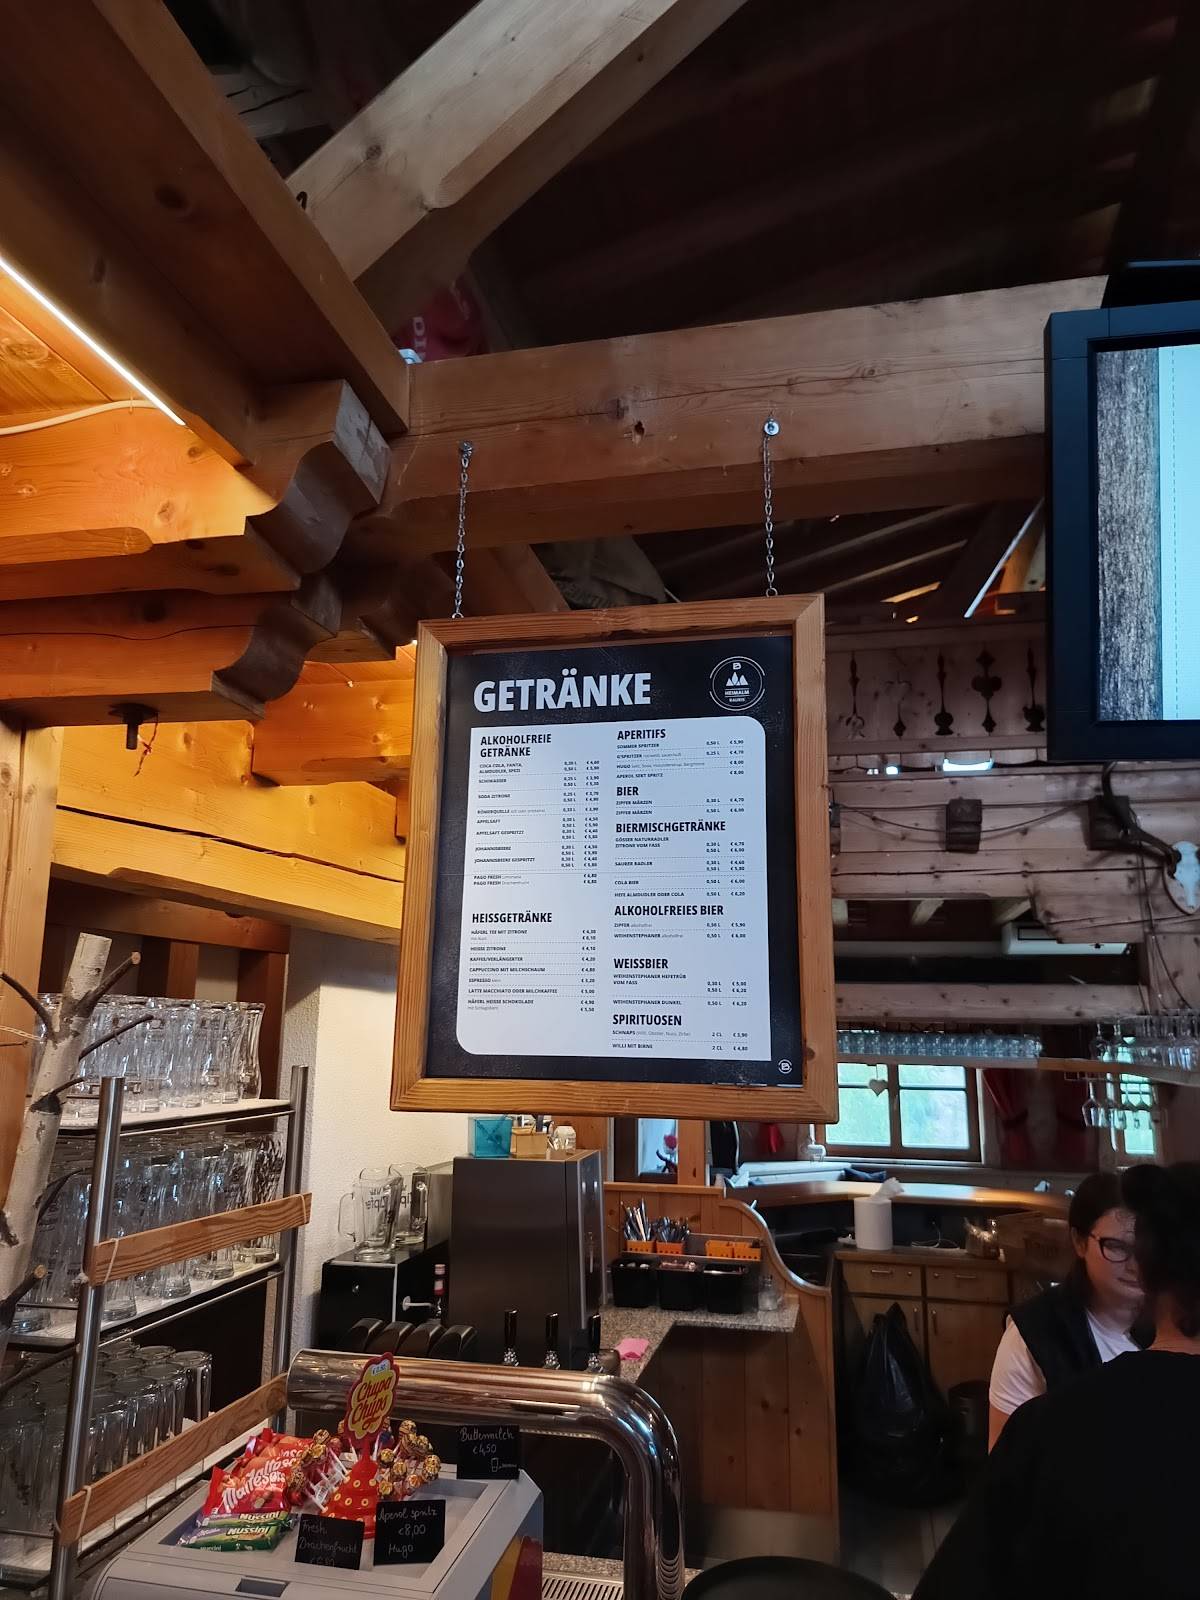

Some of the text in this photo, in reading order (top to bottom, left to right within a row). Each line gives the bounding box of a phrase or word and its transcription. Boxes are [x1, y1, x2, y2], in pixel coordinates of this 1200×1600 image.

[473, 668, 651, 712] GETRÄNKE
[480, 734, 552, 746] ALKOHOLFREIE
[617, 728, 666, 740] APERITIFS
[480, 745, 530, 758] GETRÄNKE
[616, 786, 639, 796] BIER
[616, 819, 726, 832] BIERMISCHGETRÄNKE
[614, 905, 724, 915] ALKOHOLFREIES BIER
[472, 910, 552, 923] HEISSGETRÄNKE
[614, 959, 668, 969] WEISSBIER
[612, 1014, 682, 1026] SPIRITUOSEN
[357, 1376, 393, 1402] Chupa
[352, 1394, 388, 1430] Chups
[226, 1525, 269, 1535] Nussini
